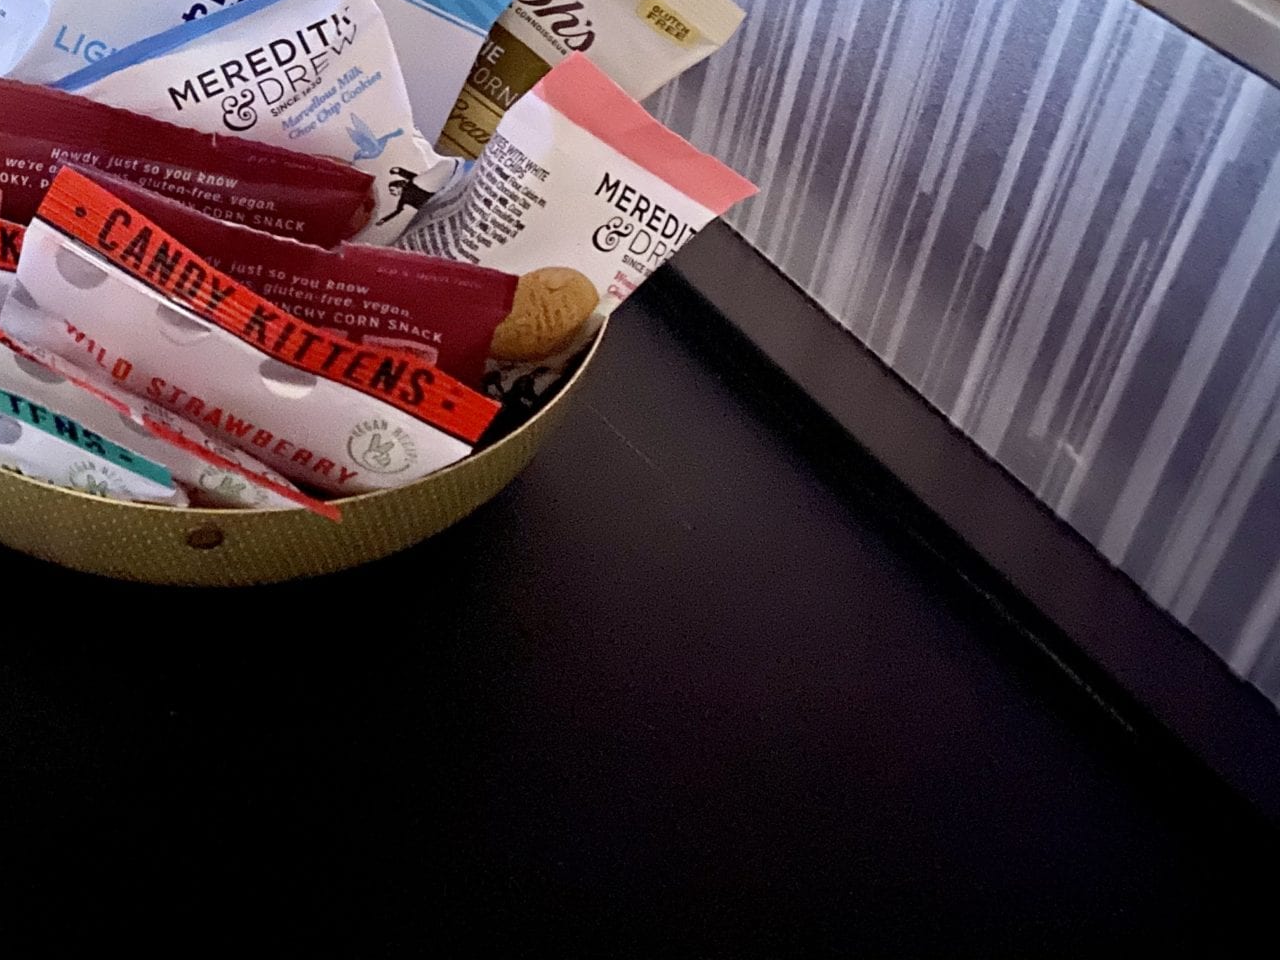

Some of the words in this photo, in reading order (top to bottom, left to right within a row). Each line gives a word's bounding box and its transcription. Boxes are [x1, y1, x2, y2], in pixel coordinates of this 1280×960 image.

[514, 7, 568, 56] CONNOISSEUR
[646, 12, 688, 42] FREE
[652, 4, 691, 36] GLUTEN
[53, 24, 117, 64] LIG
[257, 24, 357, 106] DREW
[270, 94, 301, 117] SINCE
[282, 84, 336, 131] Marvellous
[337, 66, 364, 93] Milk
[289, 117, 317, 141] Choc
[317, 102, 342, 126] Chip
[341, 70, 383, 104] Cookies
[472, 67, 519, 107] ORN
[5, 156, 44, 172] we're
[106, 154, 138, 171] just
[143, 162, 160, 175] so
[163, 168, 192, 182] you
[196, 171, 239, 189] know
[524, 158, 550, 183] WHITE
[202, 205, 245, 222] CORN
[253, 214, 306, 232] SNACK
[594, 171, 699, 246] MEREDIT
[229, 262, 262, 278] just
[268, 268, 286, 281] so
[292, 275, 320, 290] you
[325, 279, 370, 295] know
[98, 207, 236, 313] CANDY
[243, 303, 437, 411] KITTENS
[275, 300, 326, 320] NCHY
[333, 311, 380, 327] CORN
[387, 318, 443, 343] SNACK
[146, 376, 359, 484] STRAWBERRY
